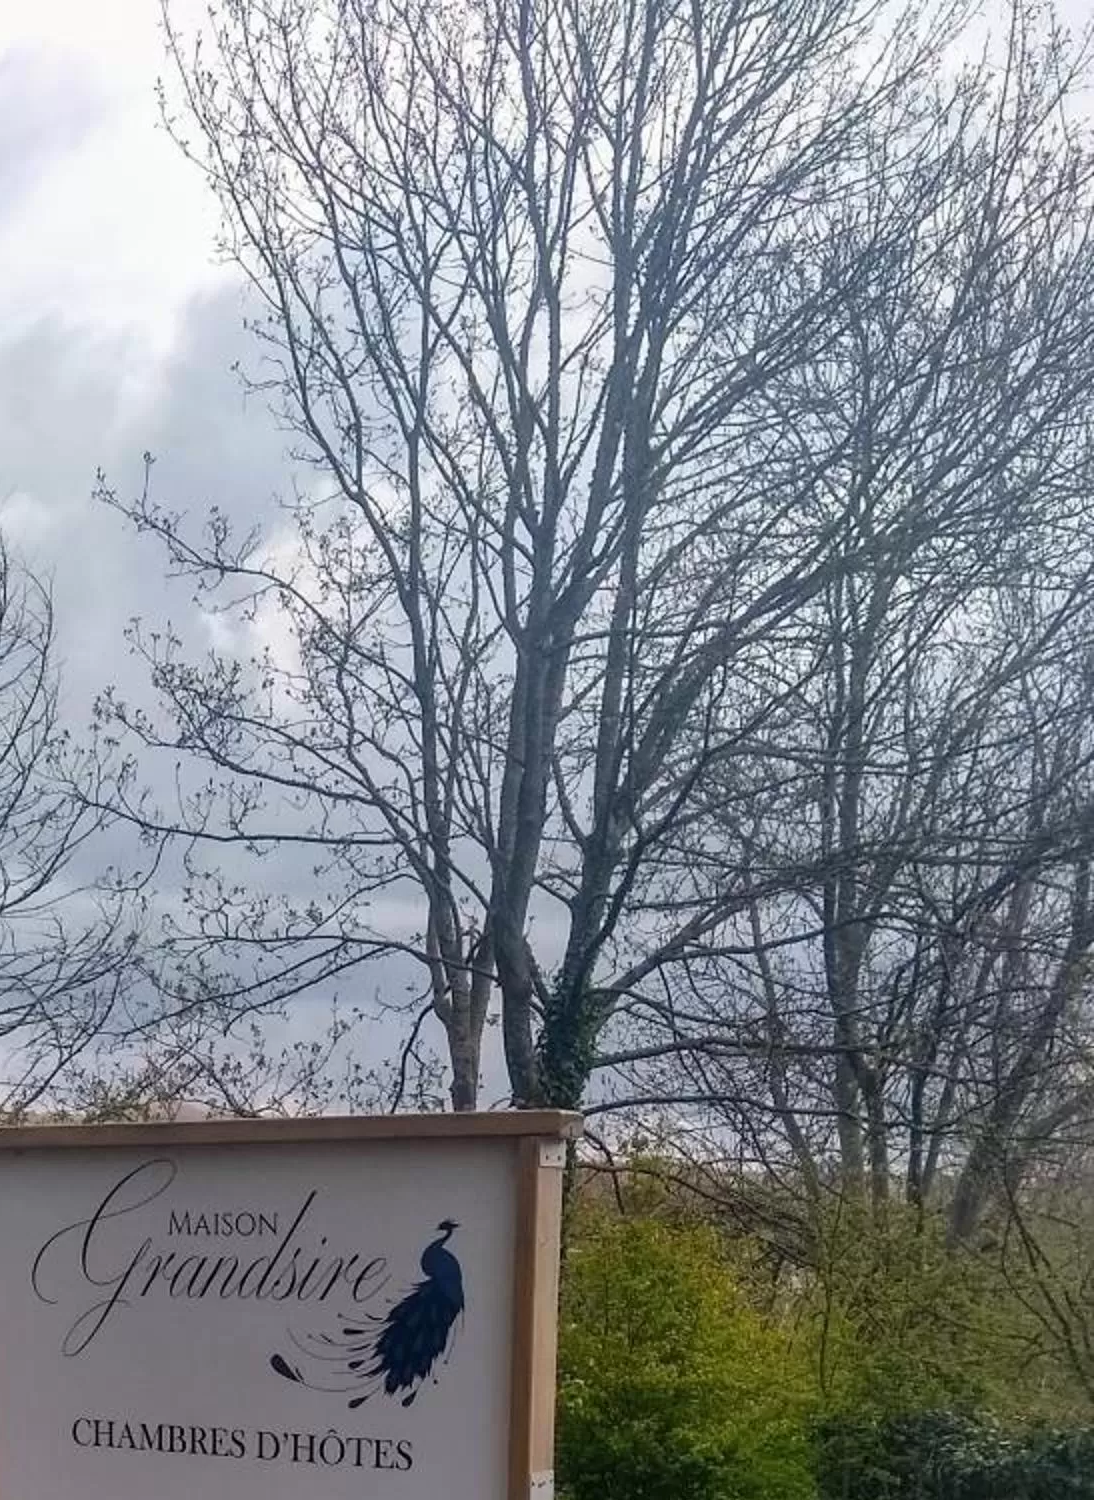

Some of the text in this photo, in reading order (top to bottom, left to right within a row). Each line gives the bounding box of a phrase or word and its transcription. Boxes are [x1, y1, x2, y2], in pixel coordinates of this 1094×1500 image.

[167, 1211, 278, 1236] MAISON
[32, 1158, 392, 1357] Grandsire
[72, 1417, 414, 1471] CHAMBRES D'HÔTES
